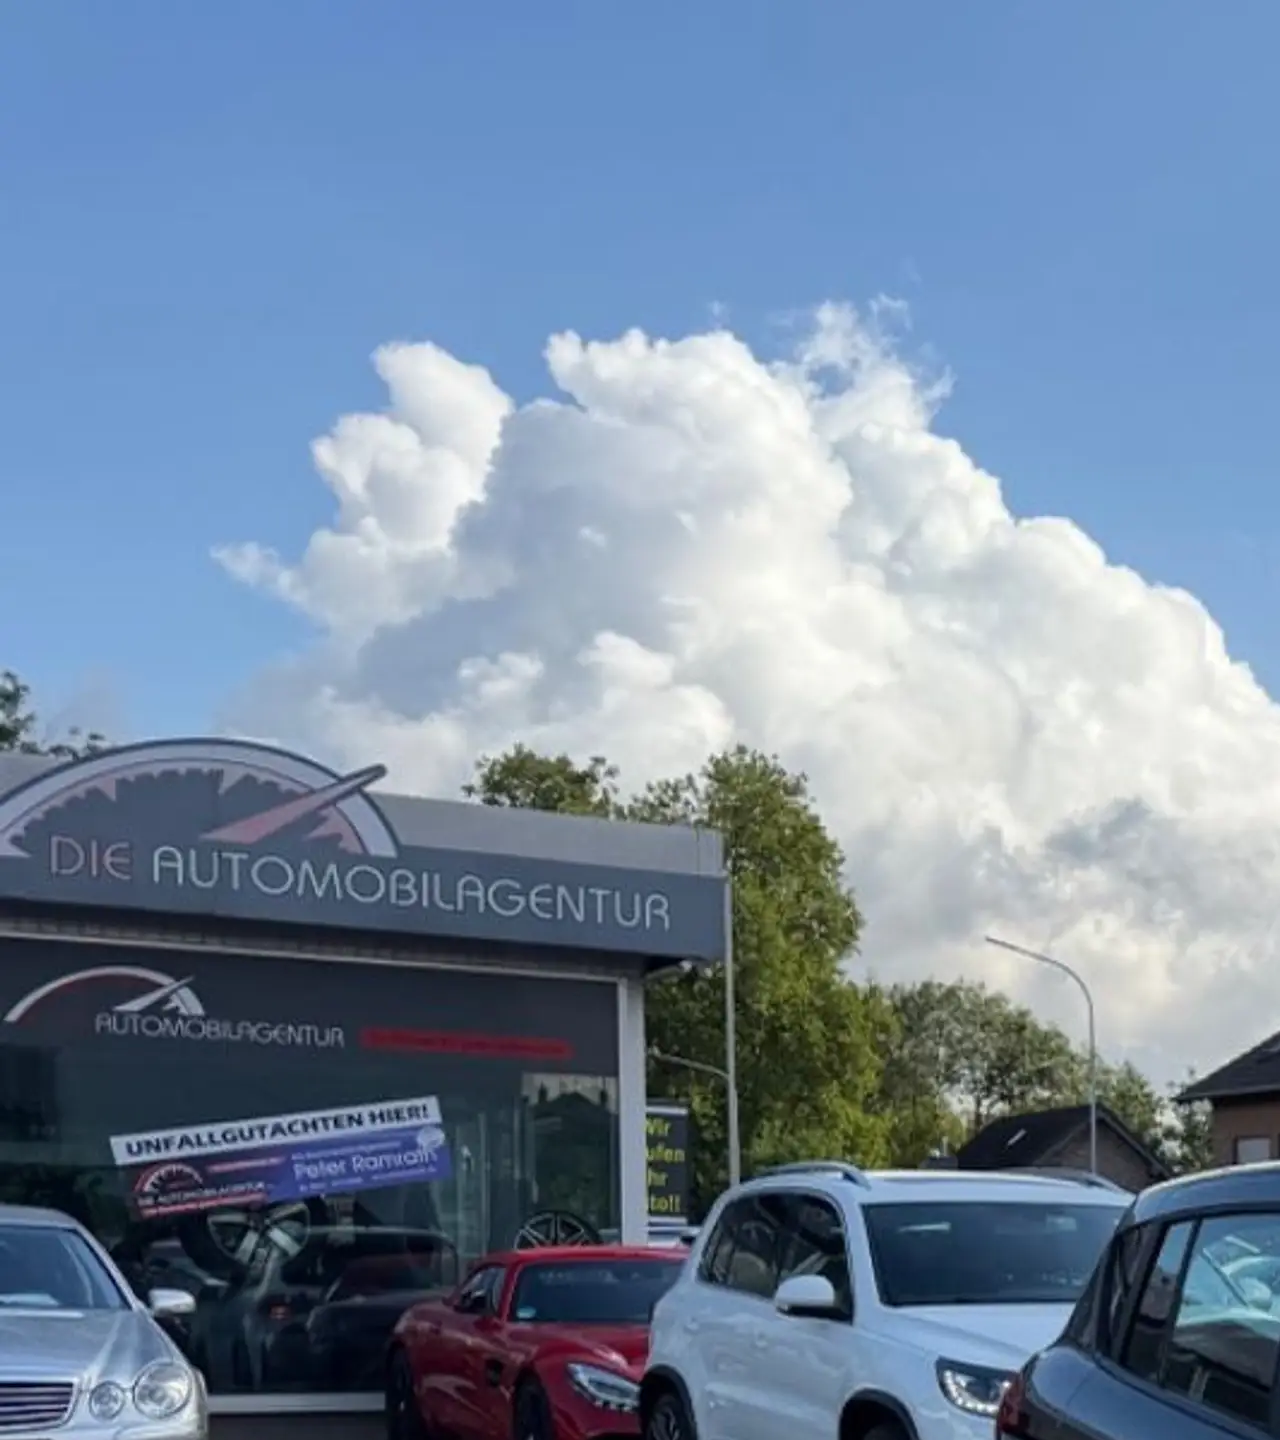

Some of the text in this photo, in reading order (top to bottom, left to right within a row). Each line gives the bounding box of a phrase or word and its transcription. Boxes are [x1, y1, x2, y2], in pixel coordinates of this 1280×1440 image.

[49, 835, 671, 932] DIE AUTOMOBILAGENTUR
[94, 1011, 344, 1048] AUTOMOBILAGENTUR
[125, 1113, 365, 1157] UNFALLGUTACHTEN
[367, 1103, 430, 1125] HIER!
